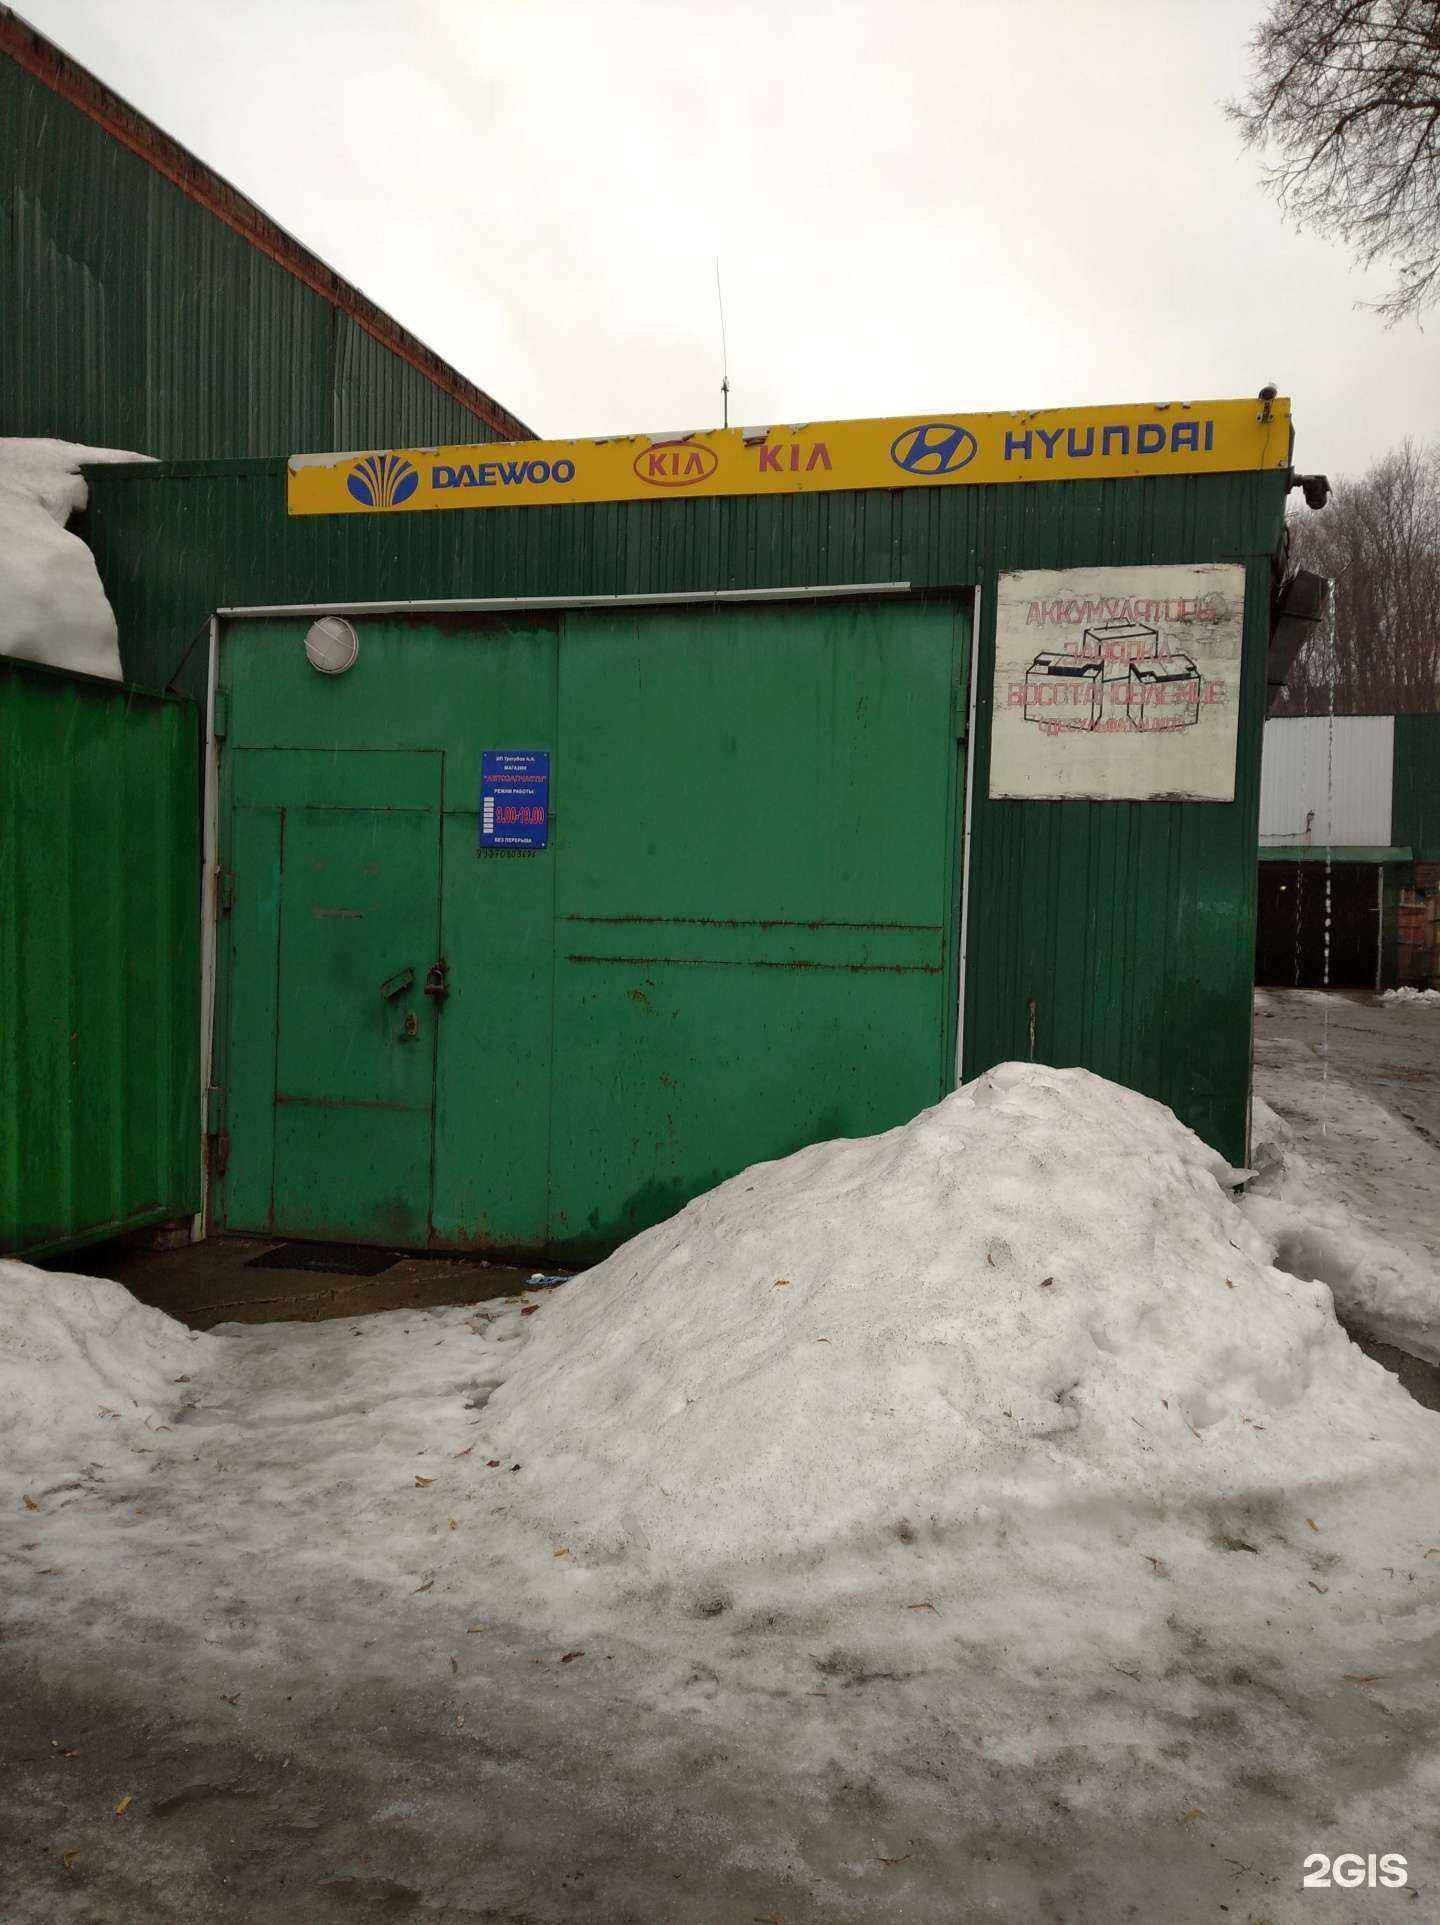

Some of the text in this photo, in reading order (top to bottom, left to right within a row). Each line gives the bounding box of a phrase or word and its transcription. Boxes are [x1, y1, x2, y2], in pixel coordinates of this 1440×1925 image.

[431, 420, 1214, 490] DAEWOO KIA KIA HYUNDAI
